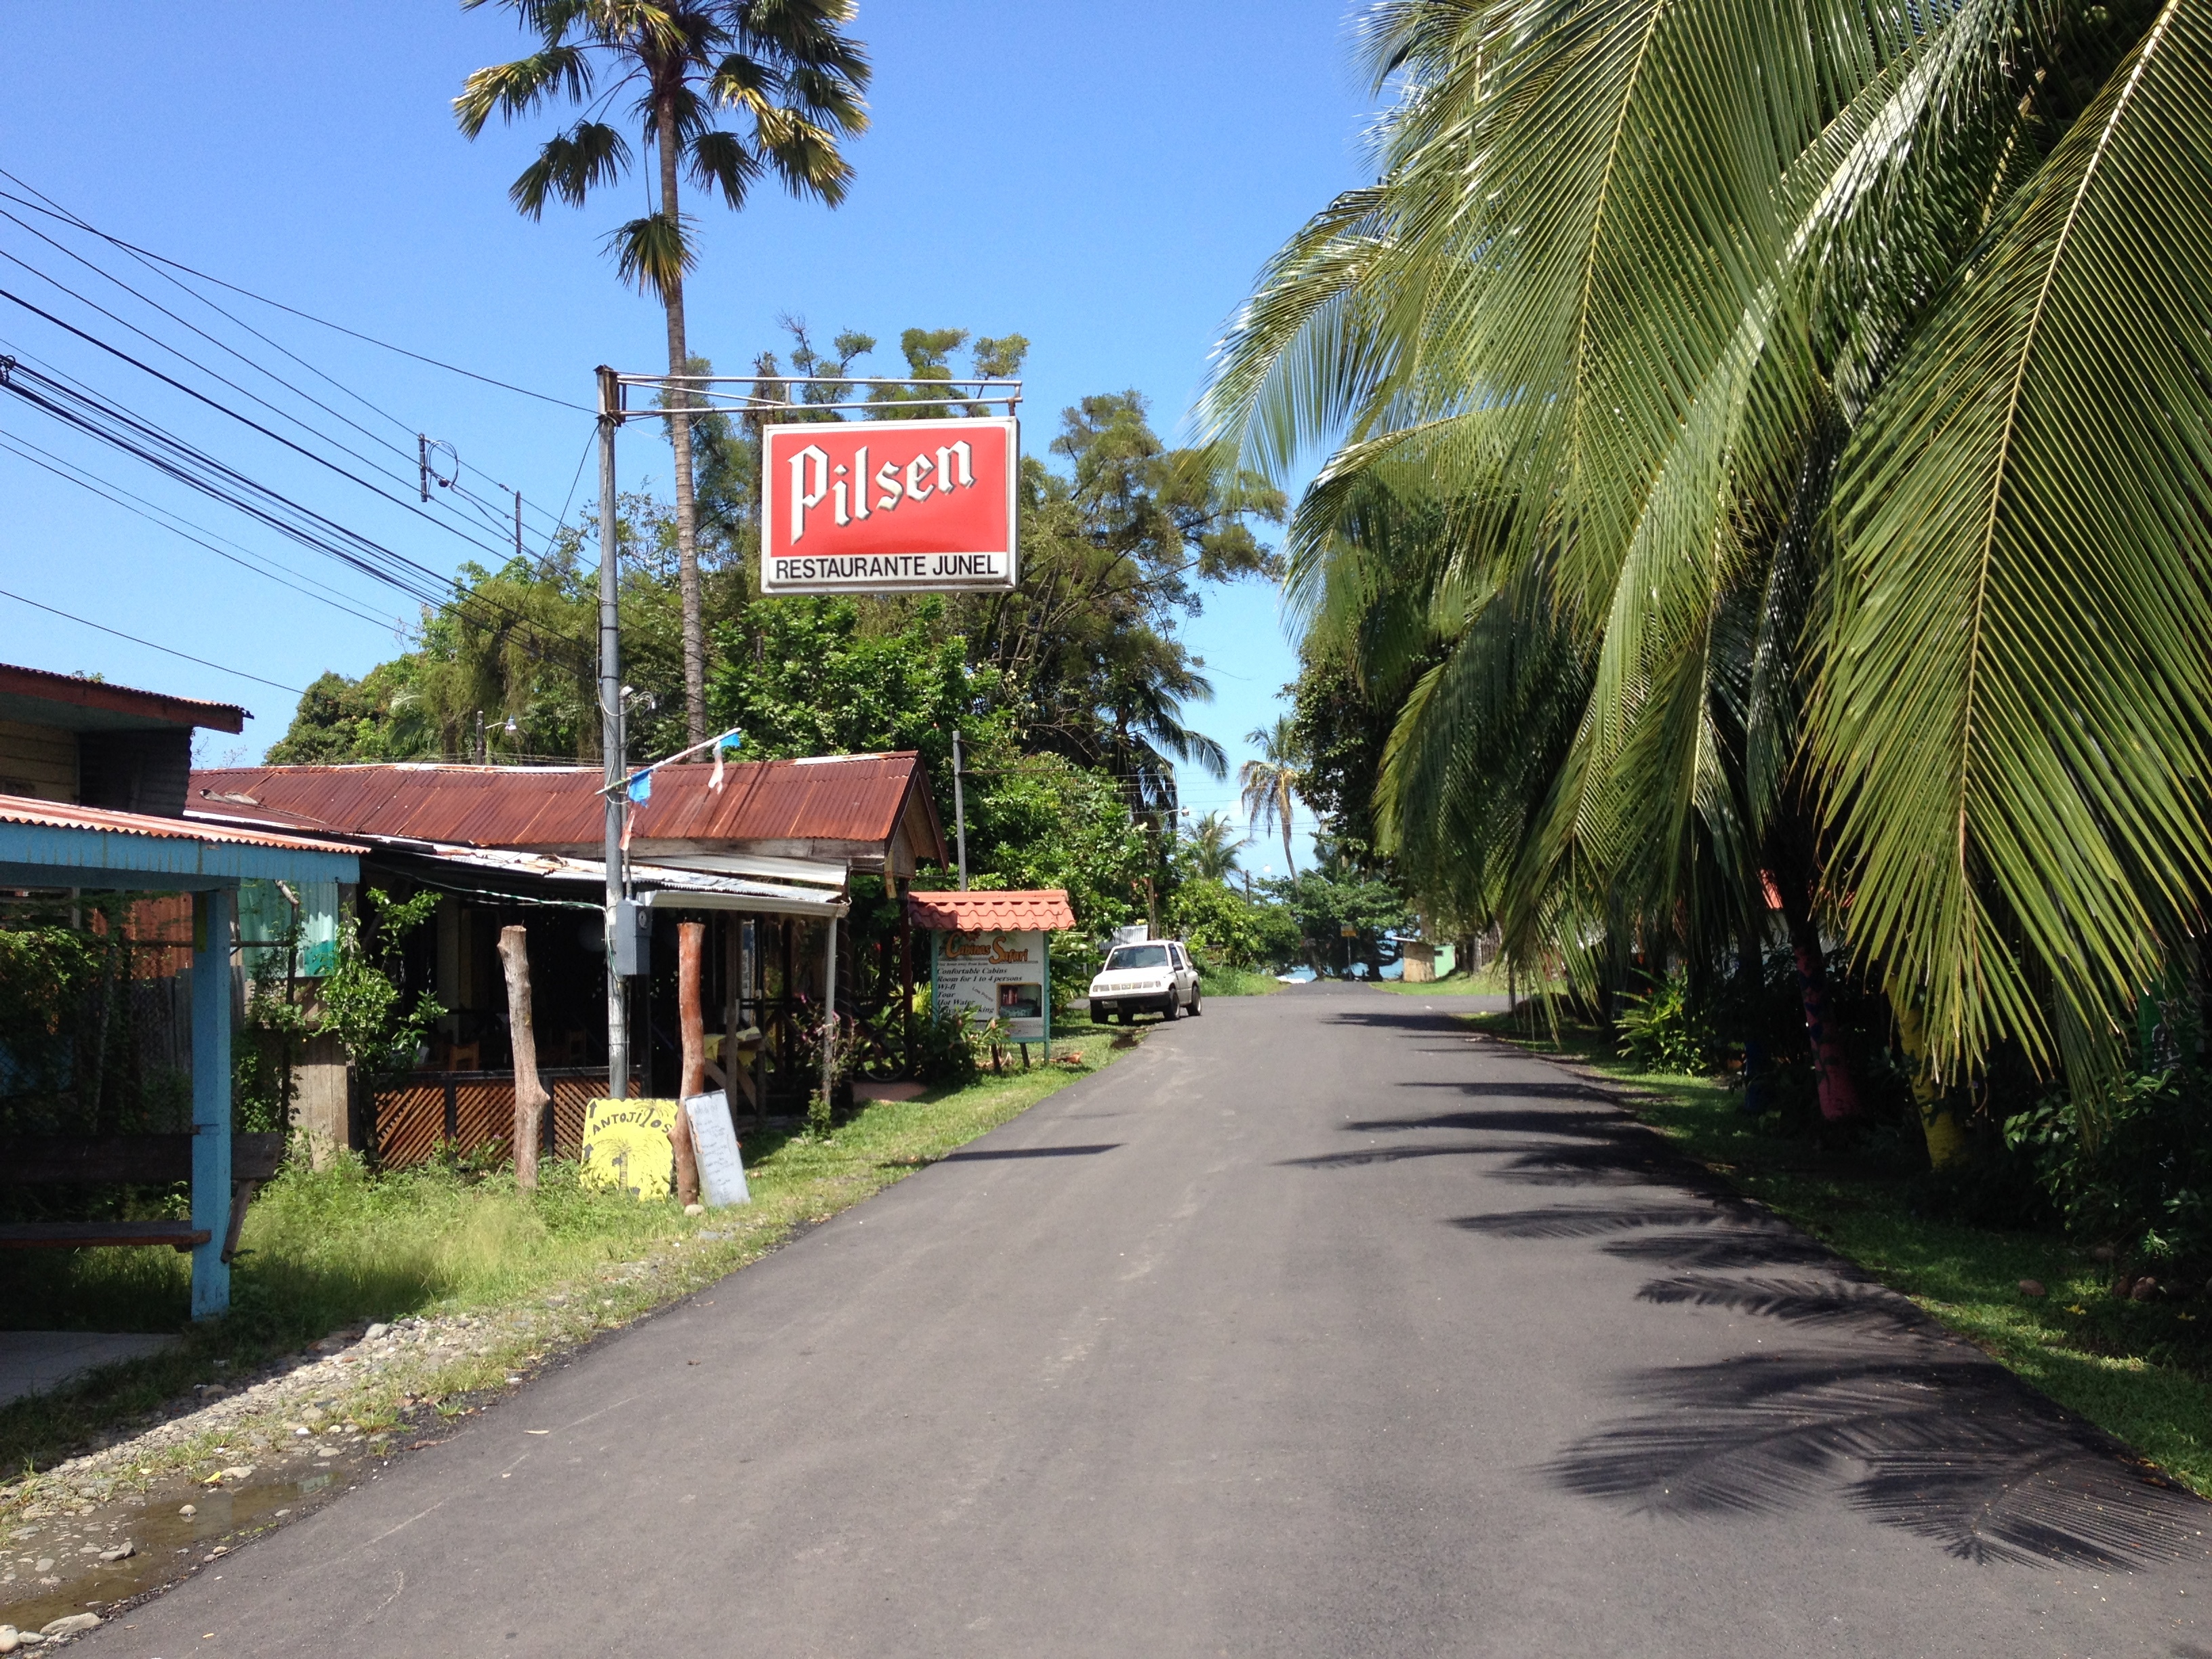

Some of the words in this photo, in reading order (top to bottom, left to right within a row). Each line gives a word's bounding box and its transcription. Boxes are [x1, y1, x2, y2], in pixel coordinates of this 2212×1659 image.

[787, 439, 977, 546] Pilsen
[776, 556, 926, 579] RESTAURANTE
[933, 554, 999, 575] JUNEL
[989, 936, 1029, 964] Safari
